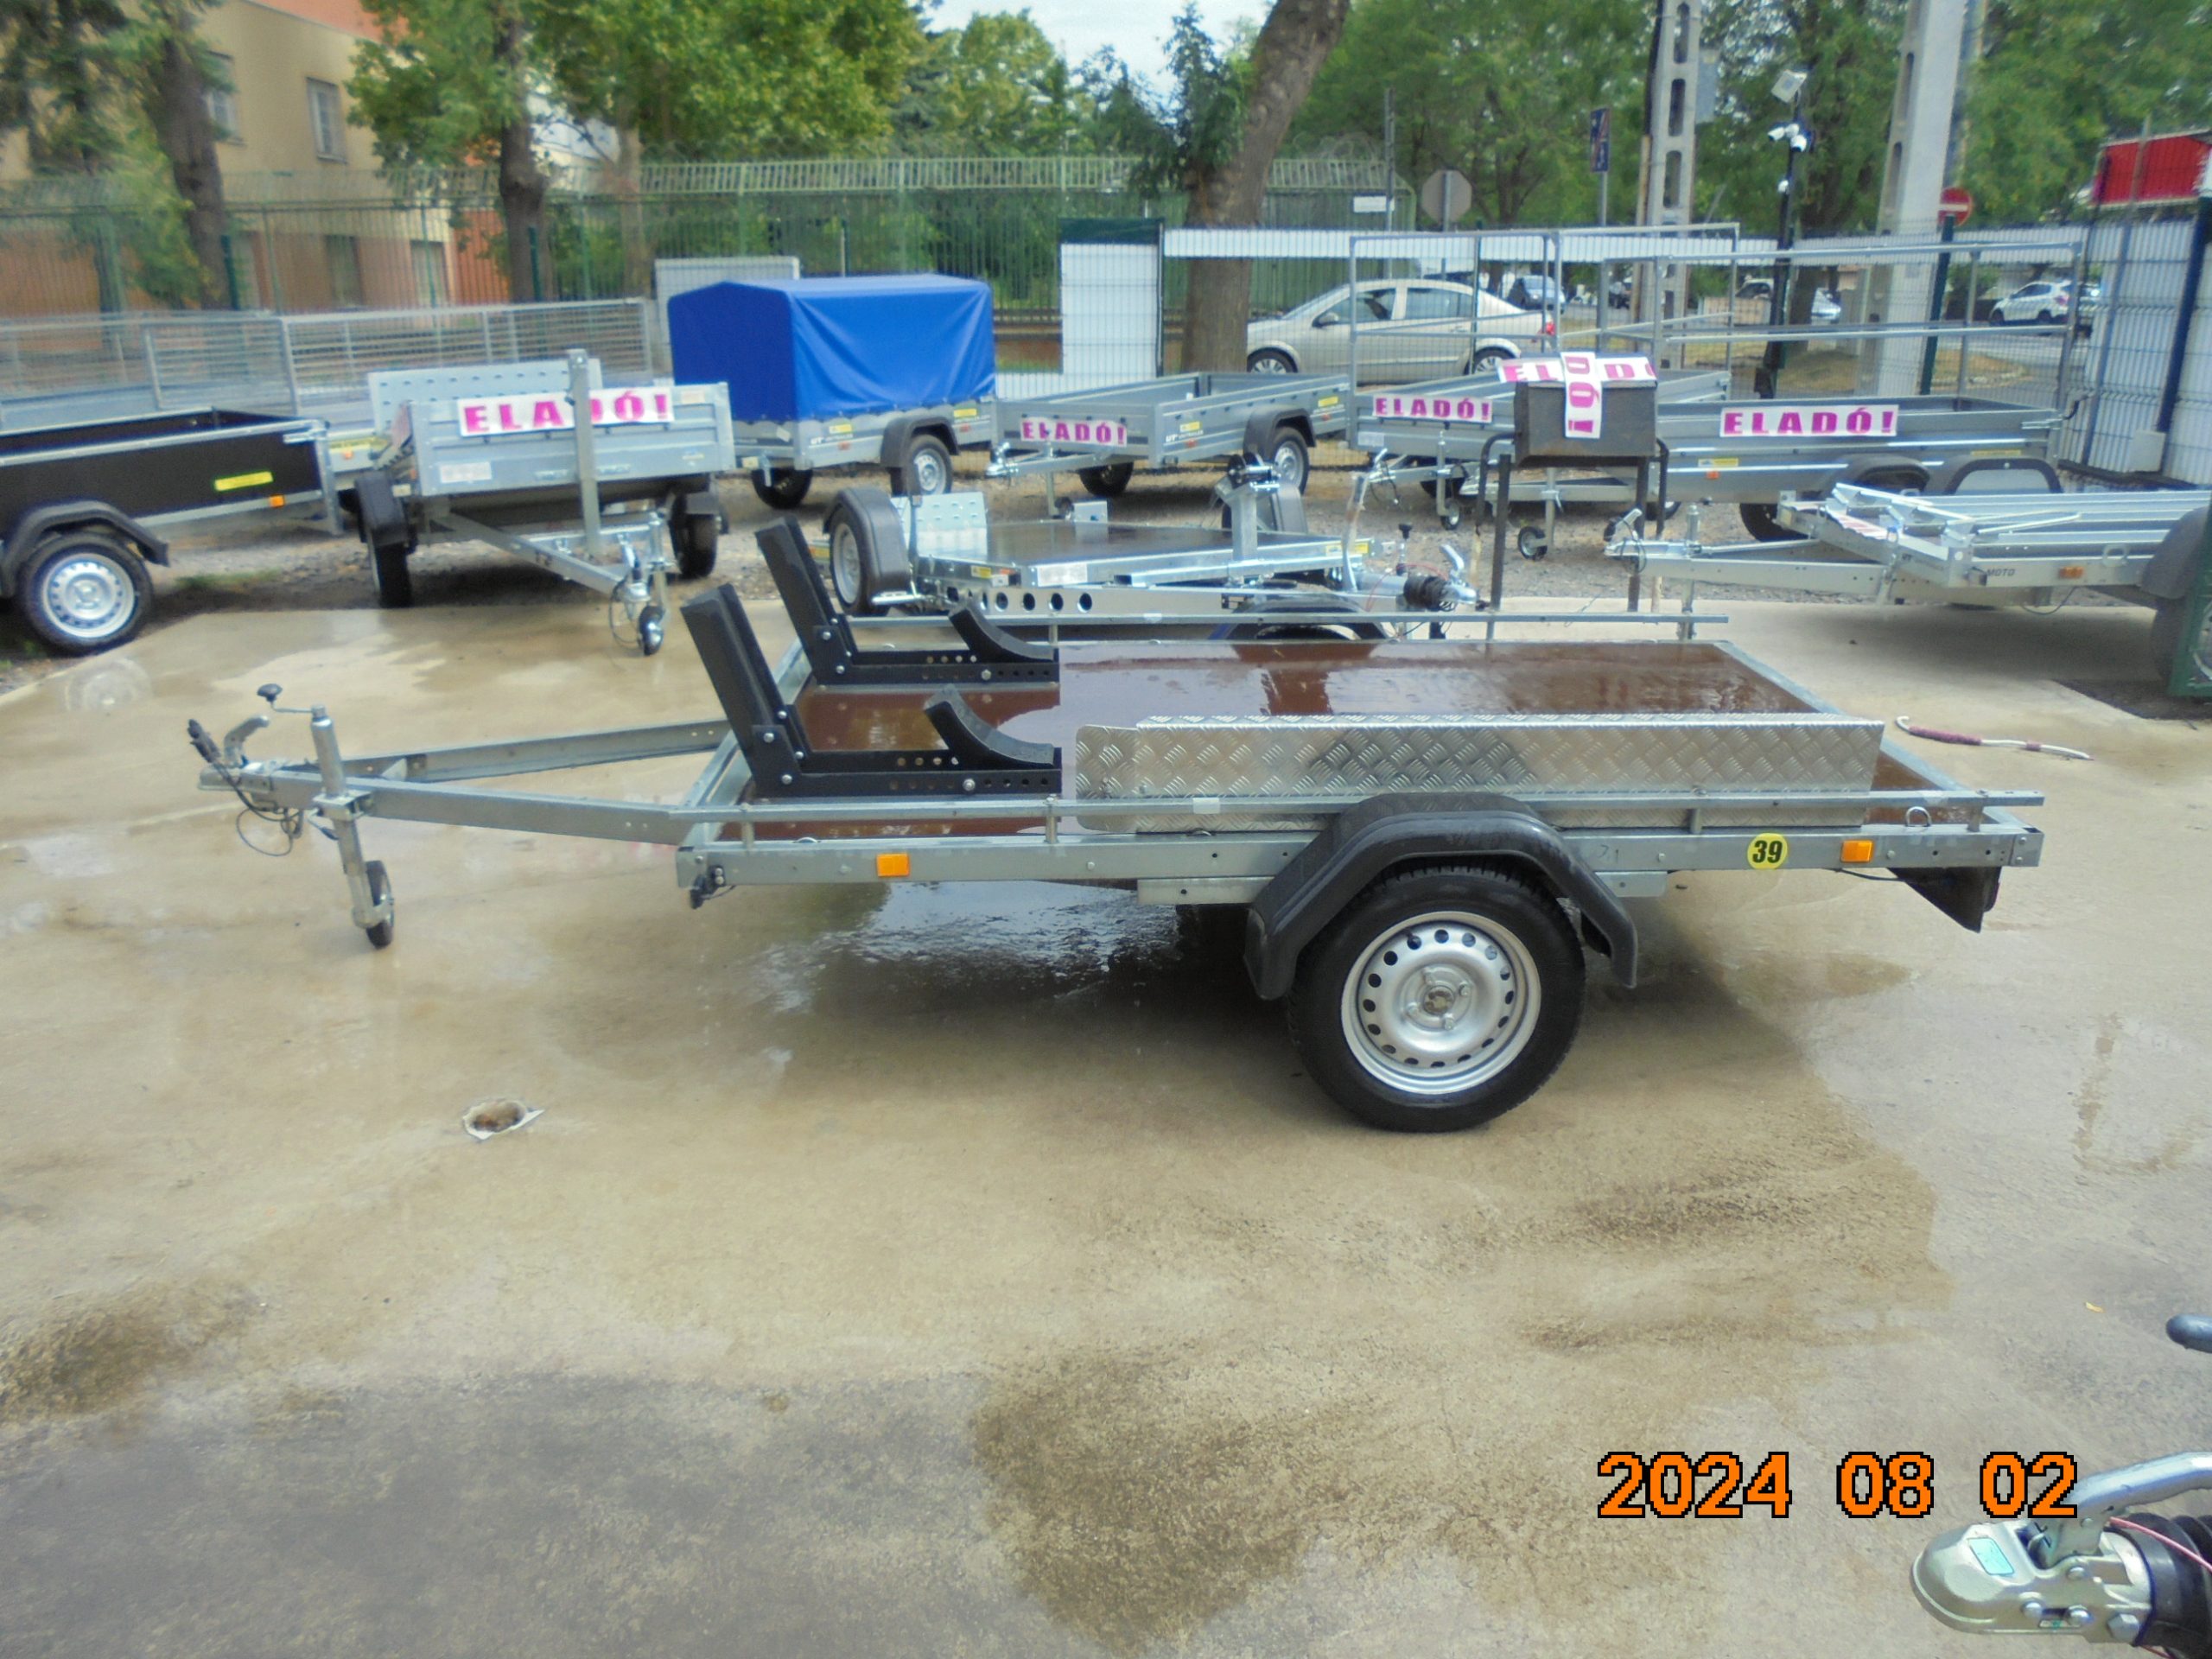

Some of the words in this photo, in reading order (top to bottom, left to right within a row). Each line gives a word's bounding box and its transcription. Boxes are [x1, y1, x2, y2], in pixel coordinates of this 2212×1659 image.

[1376, 397, 1490, 421] ELADÓ!
[1724, 407, 1895, 435] ELADÓ!
[1022, 421, 1127, 445] ELADÓ!
[1751, 839, 1783, 864] 39
